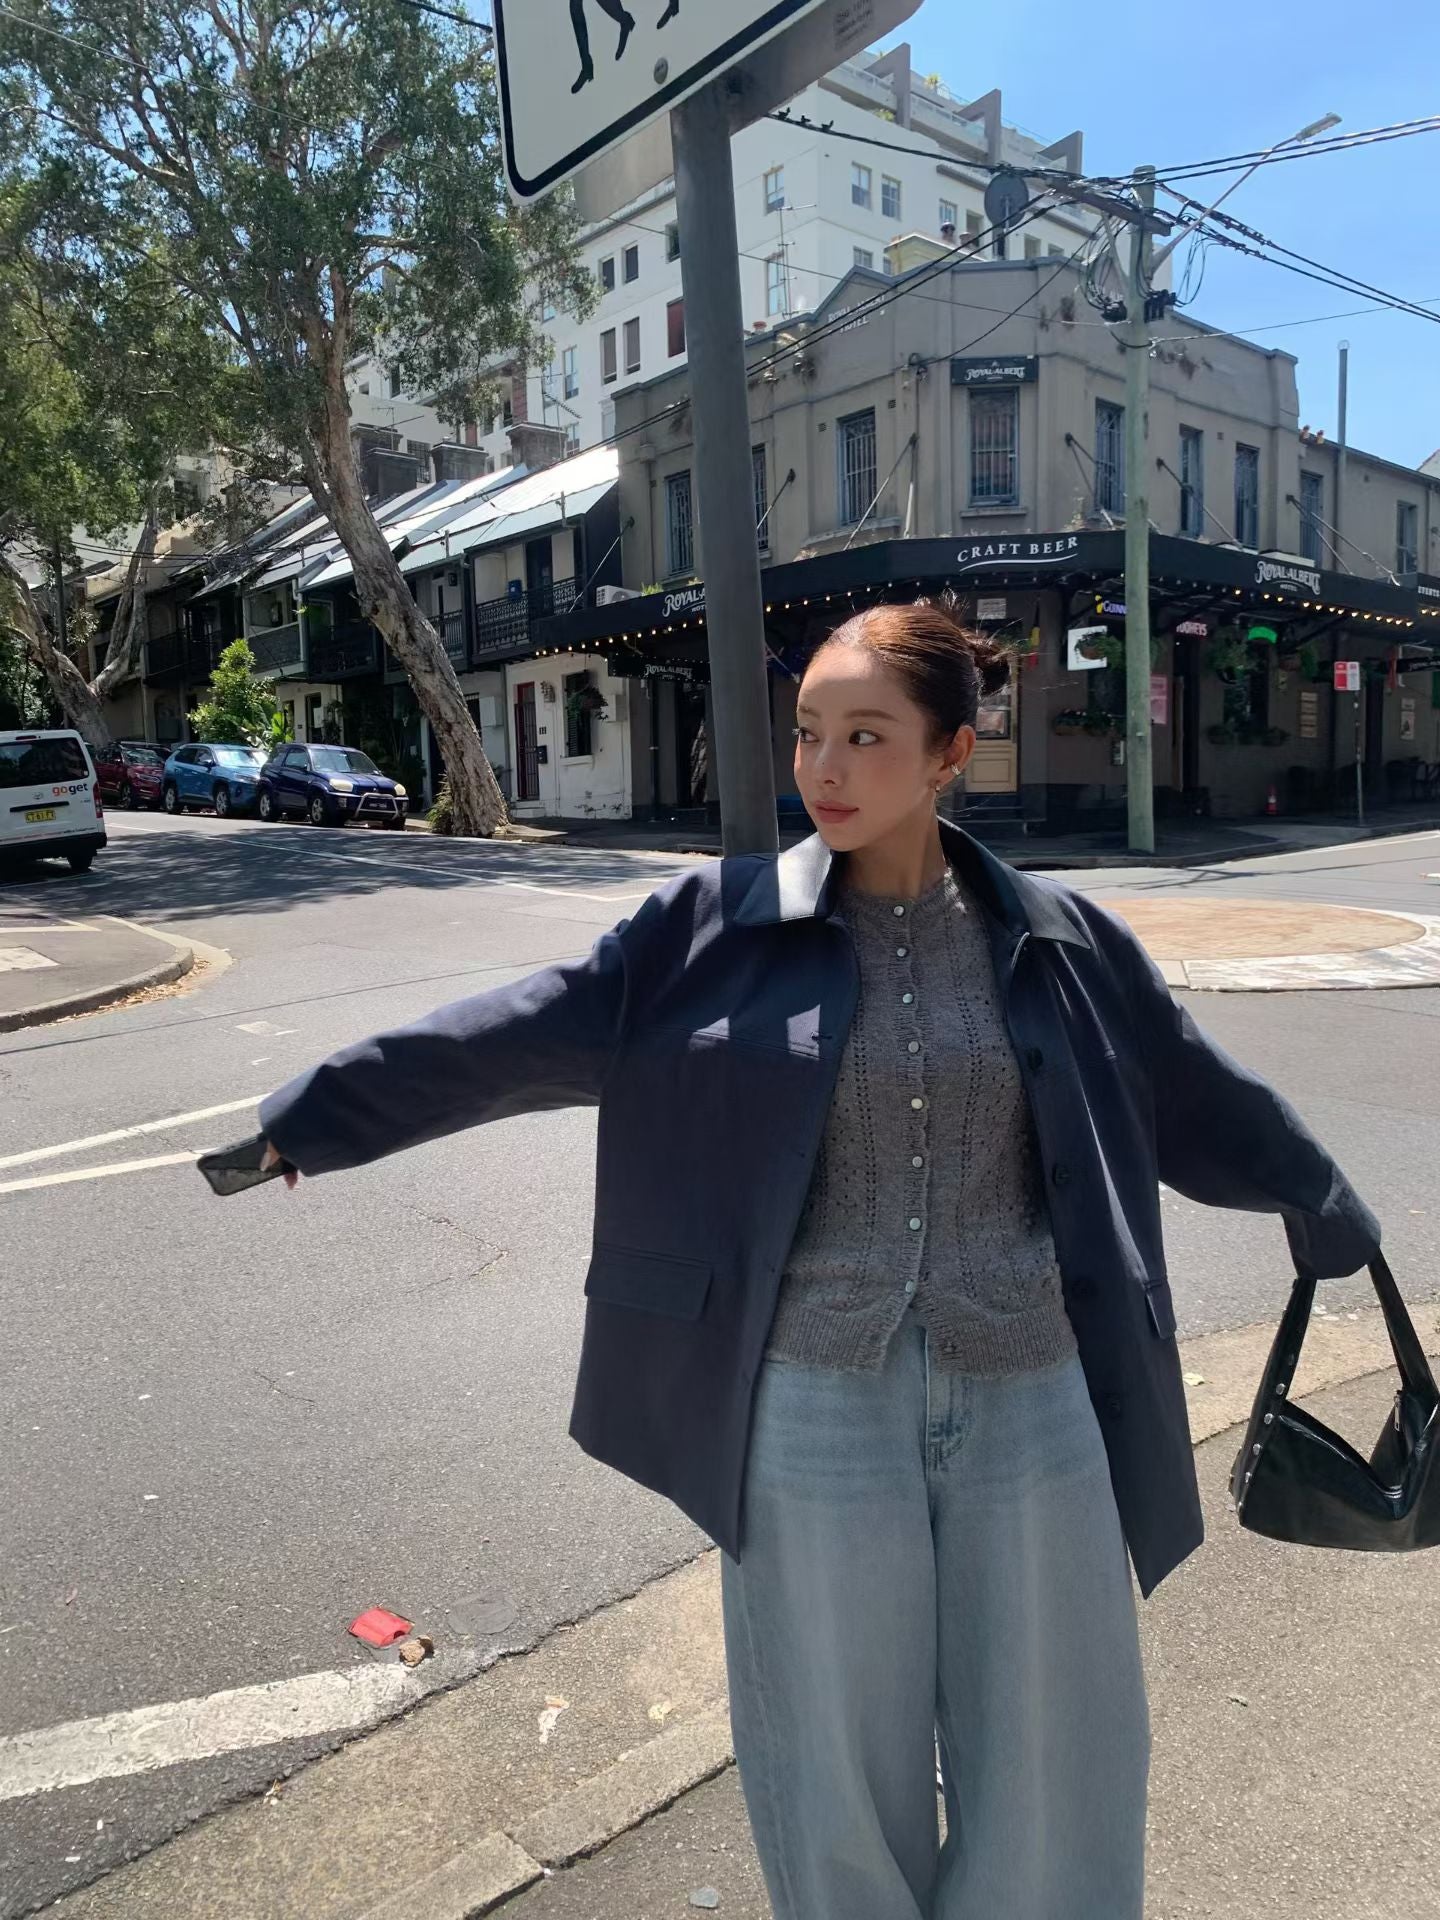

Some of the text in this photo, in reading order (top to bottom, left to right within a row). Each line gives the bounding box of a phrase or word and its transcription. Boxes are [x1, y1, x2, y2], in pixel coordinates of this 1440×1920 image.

[964, 367, 1026, 381] ROYAL ALBERT
[957, 536, 1078, 563] CRAFT BEER
[1255, 560, 1321, 595] ROYAL ALBERT
[661, 589, 699, 618] ROYAL
[52, 782, 89, 797] goget
